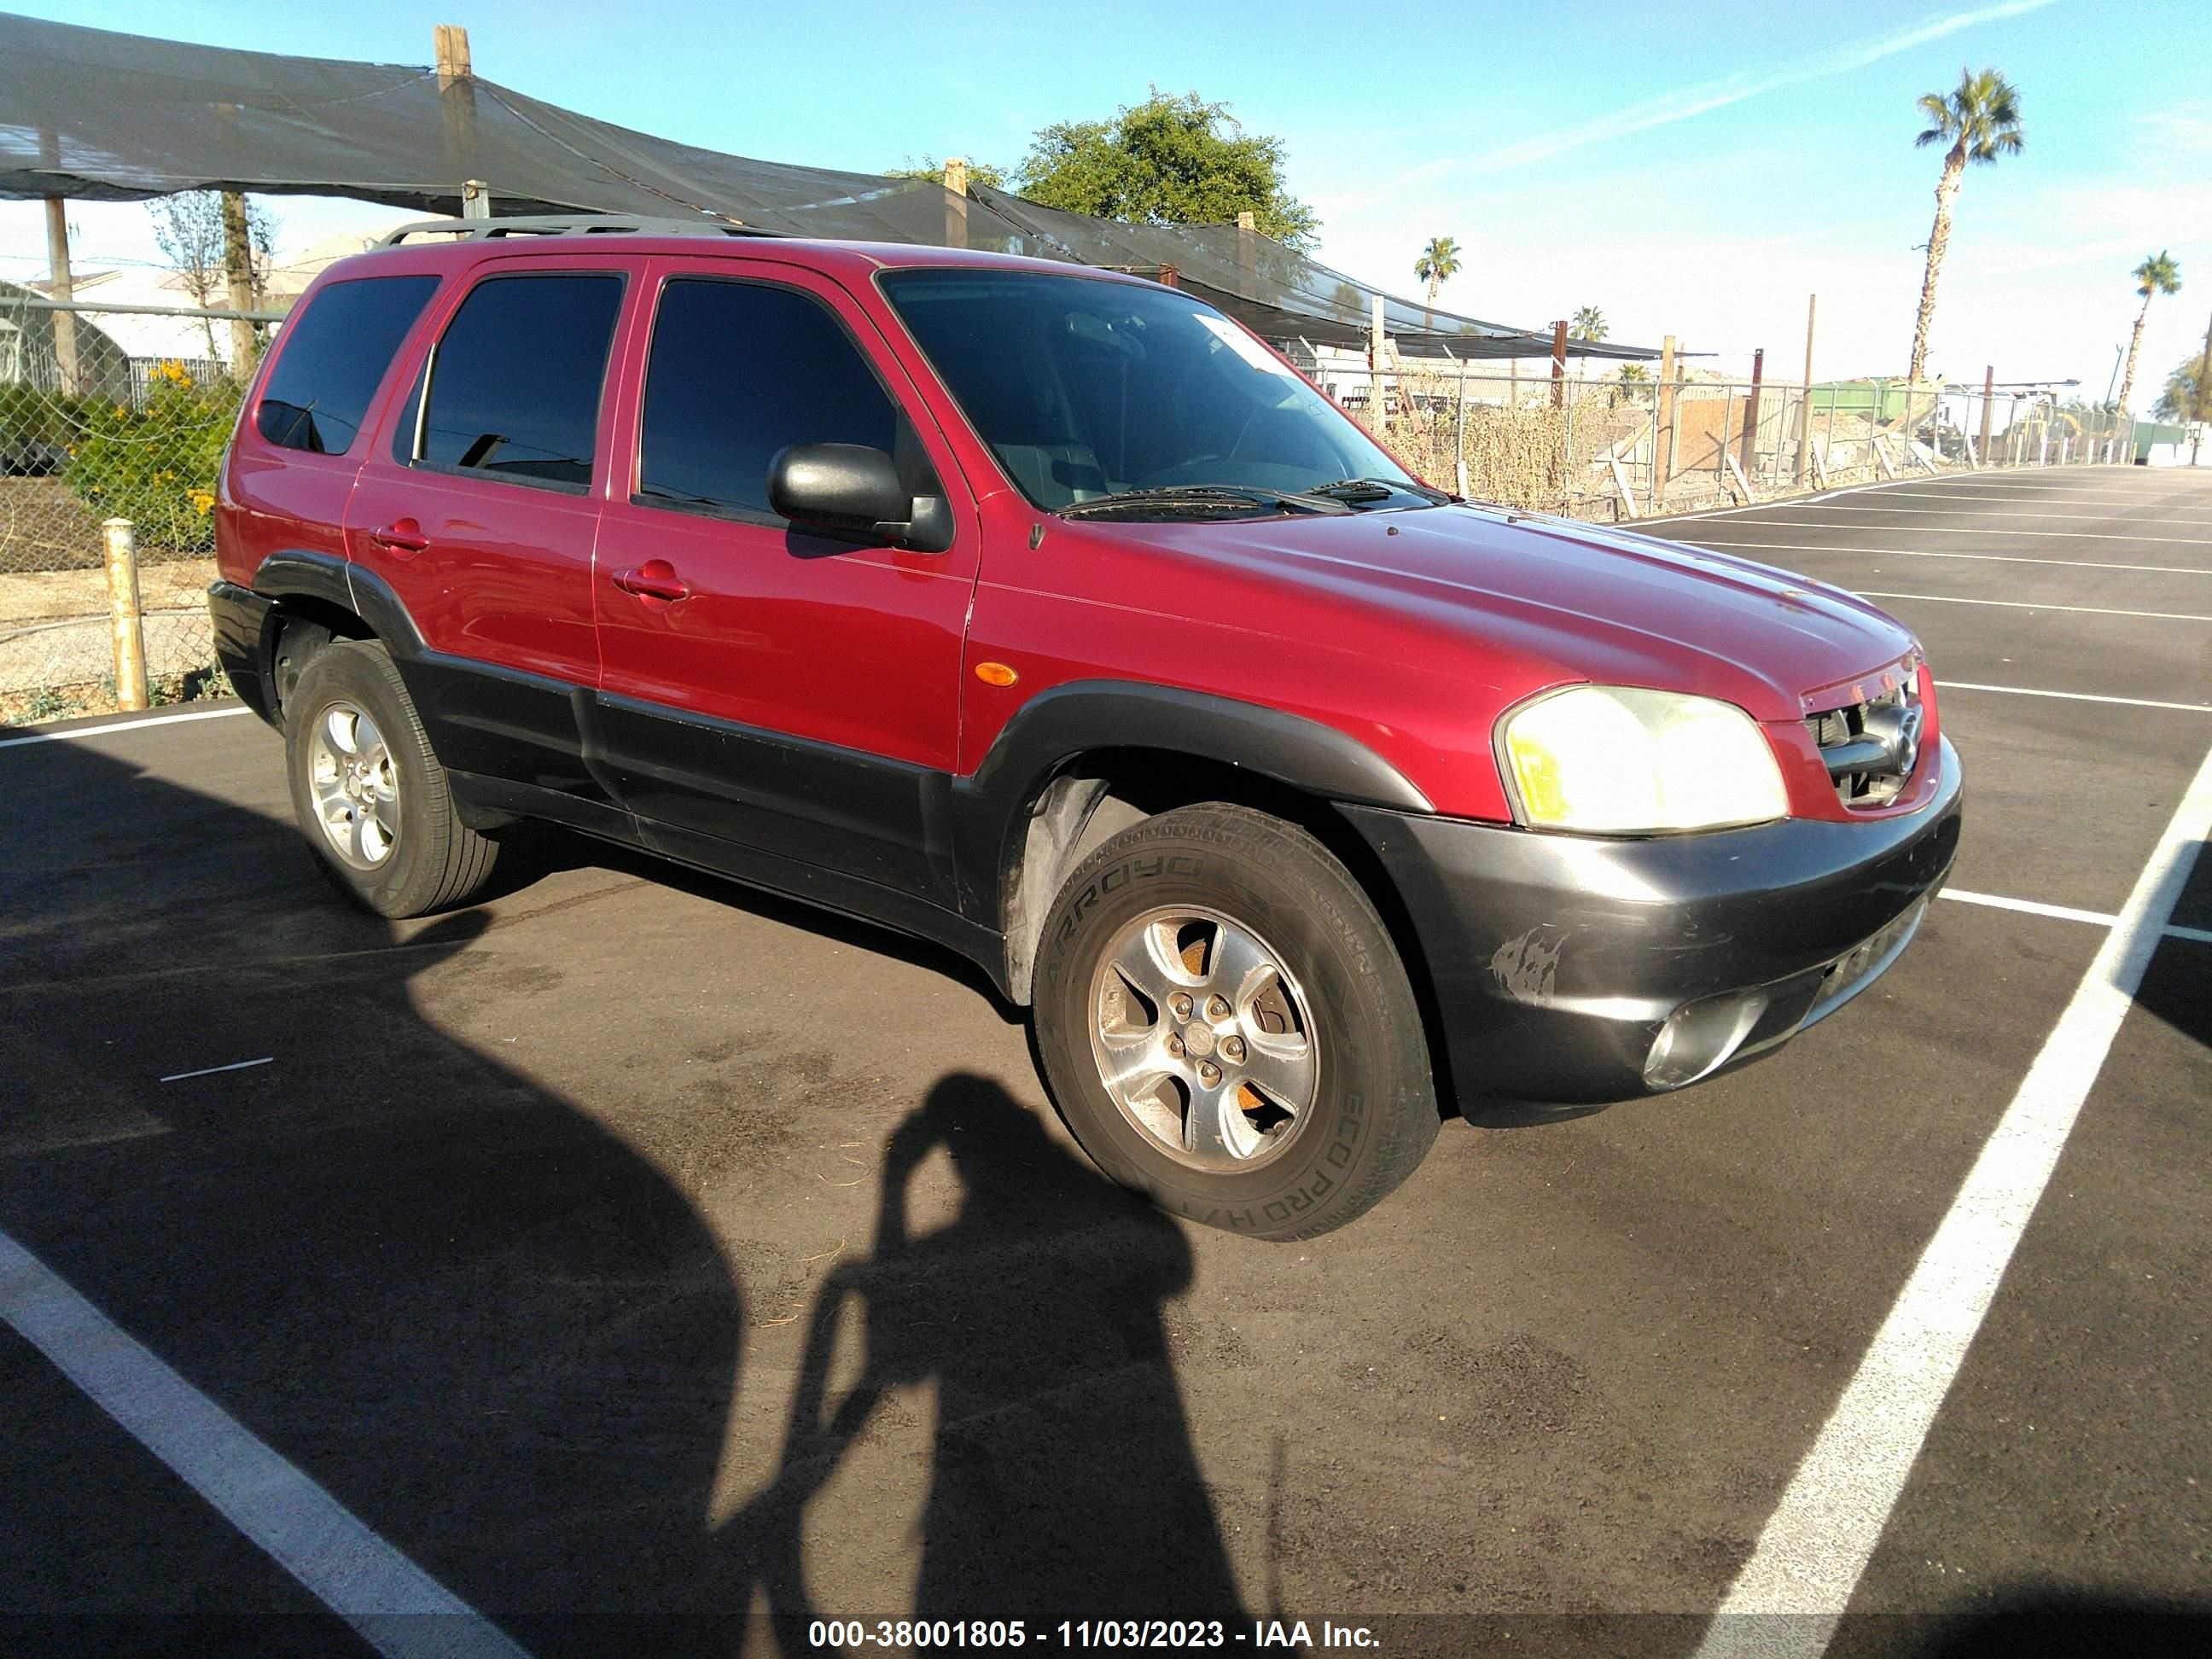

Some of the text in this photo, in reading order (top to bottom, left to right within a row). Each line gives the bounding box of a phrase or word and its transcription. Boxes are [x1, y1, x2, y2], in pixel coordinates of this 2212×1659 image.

[1046, 855, 1204, 985] ARROYO
[1325, 1088, 1365, 1170] ECO
[1262, 1170, 1335, 1223] PRO
